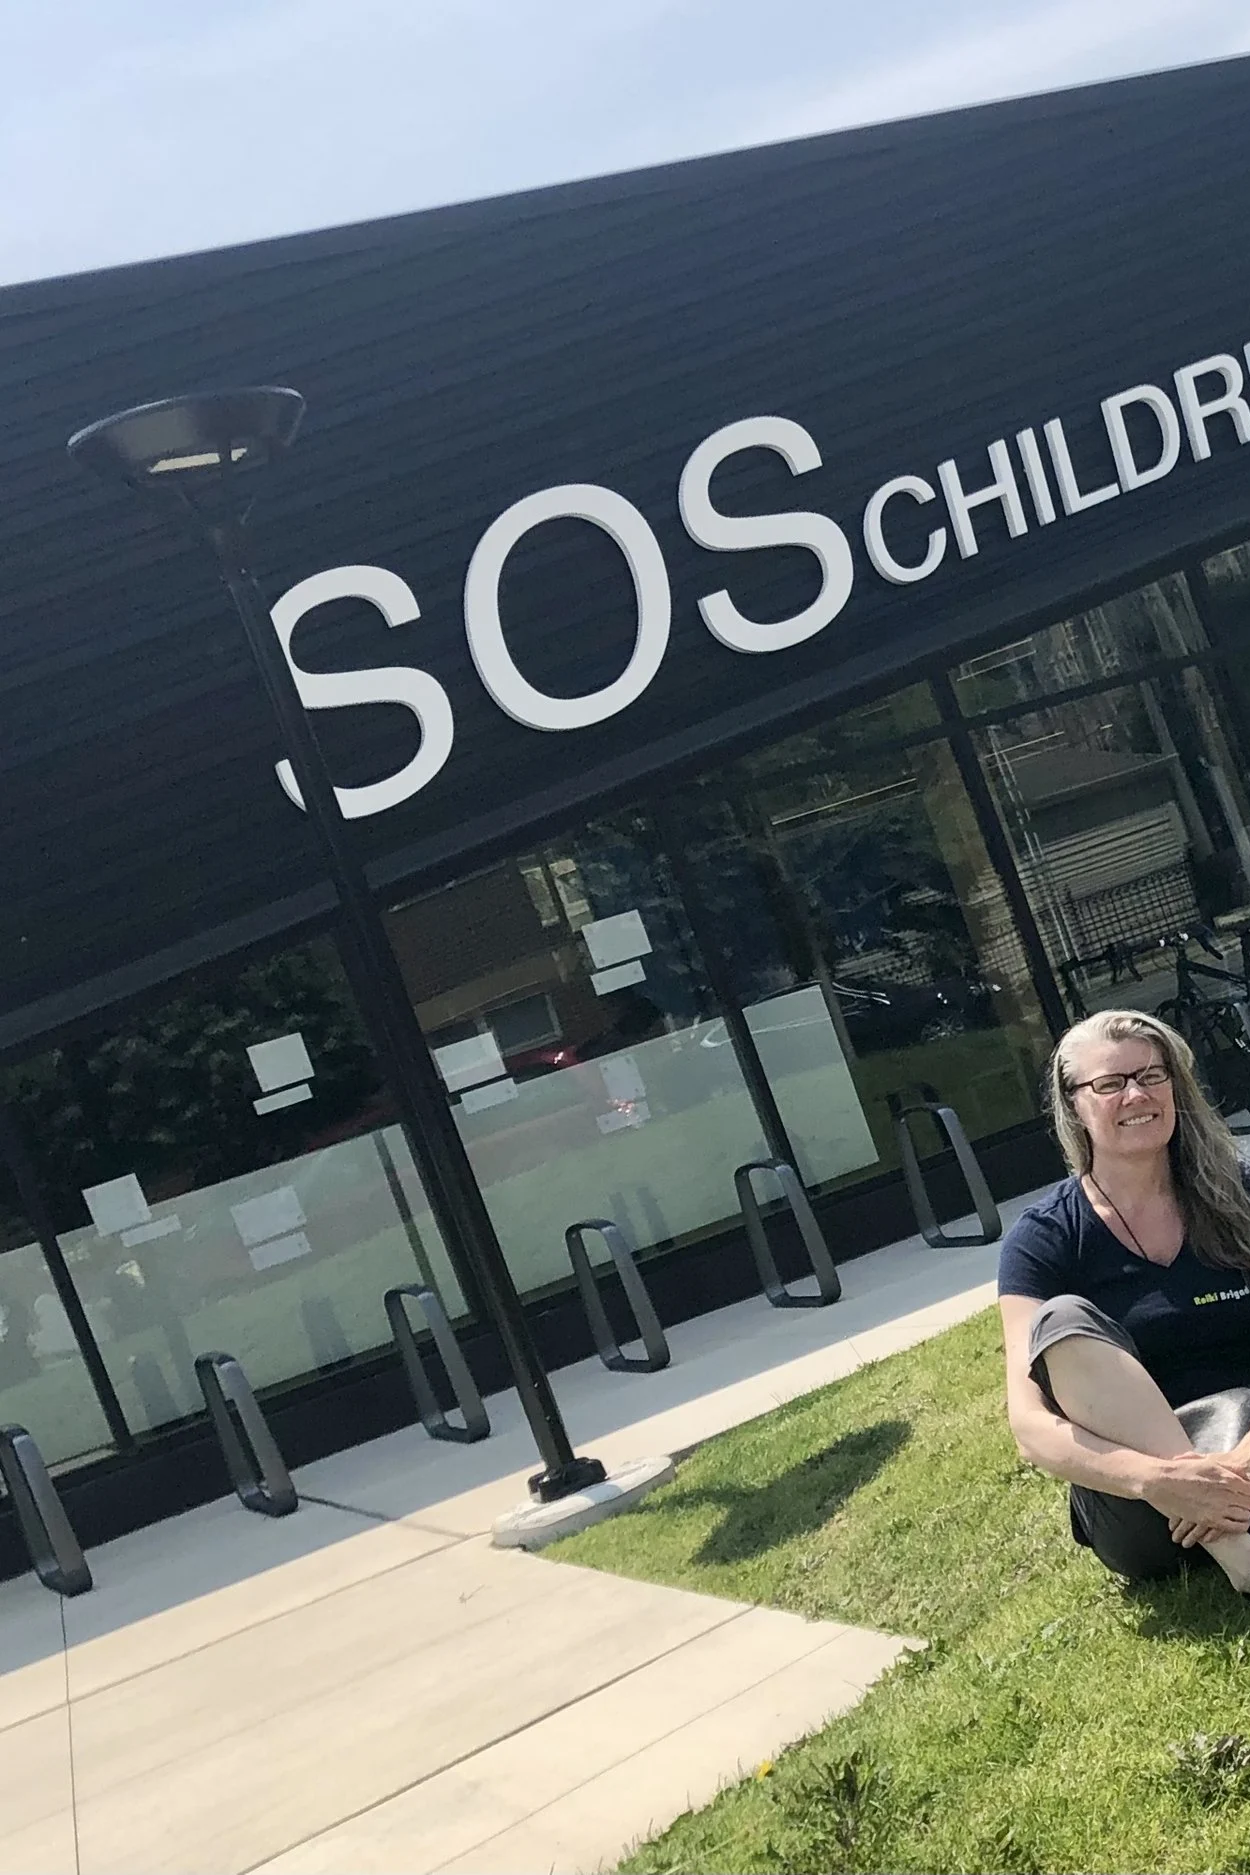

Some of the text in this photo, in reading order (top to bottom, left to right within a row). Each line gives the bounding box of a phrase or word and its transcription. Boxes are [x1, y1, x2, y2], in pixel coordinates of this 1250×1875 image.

[270, 416, 854, 819] SOS
[1193, 1286, 1250, 1306] Reiki Brigad
